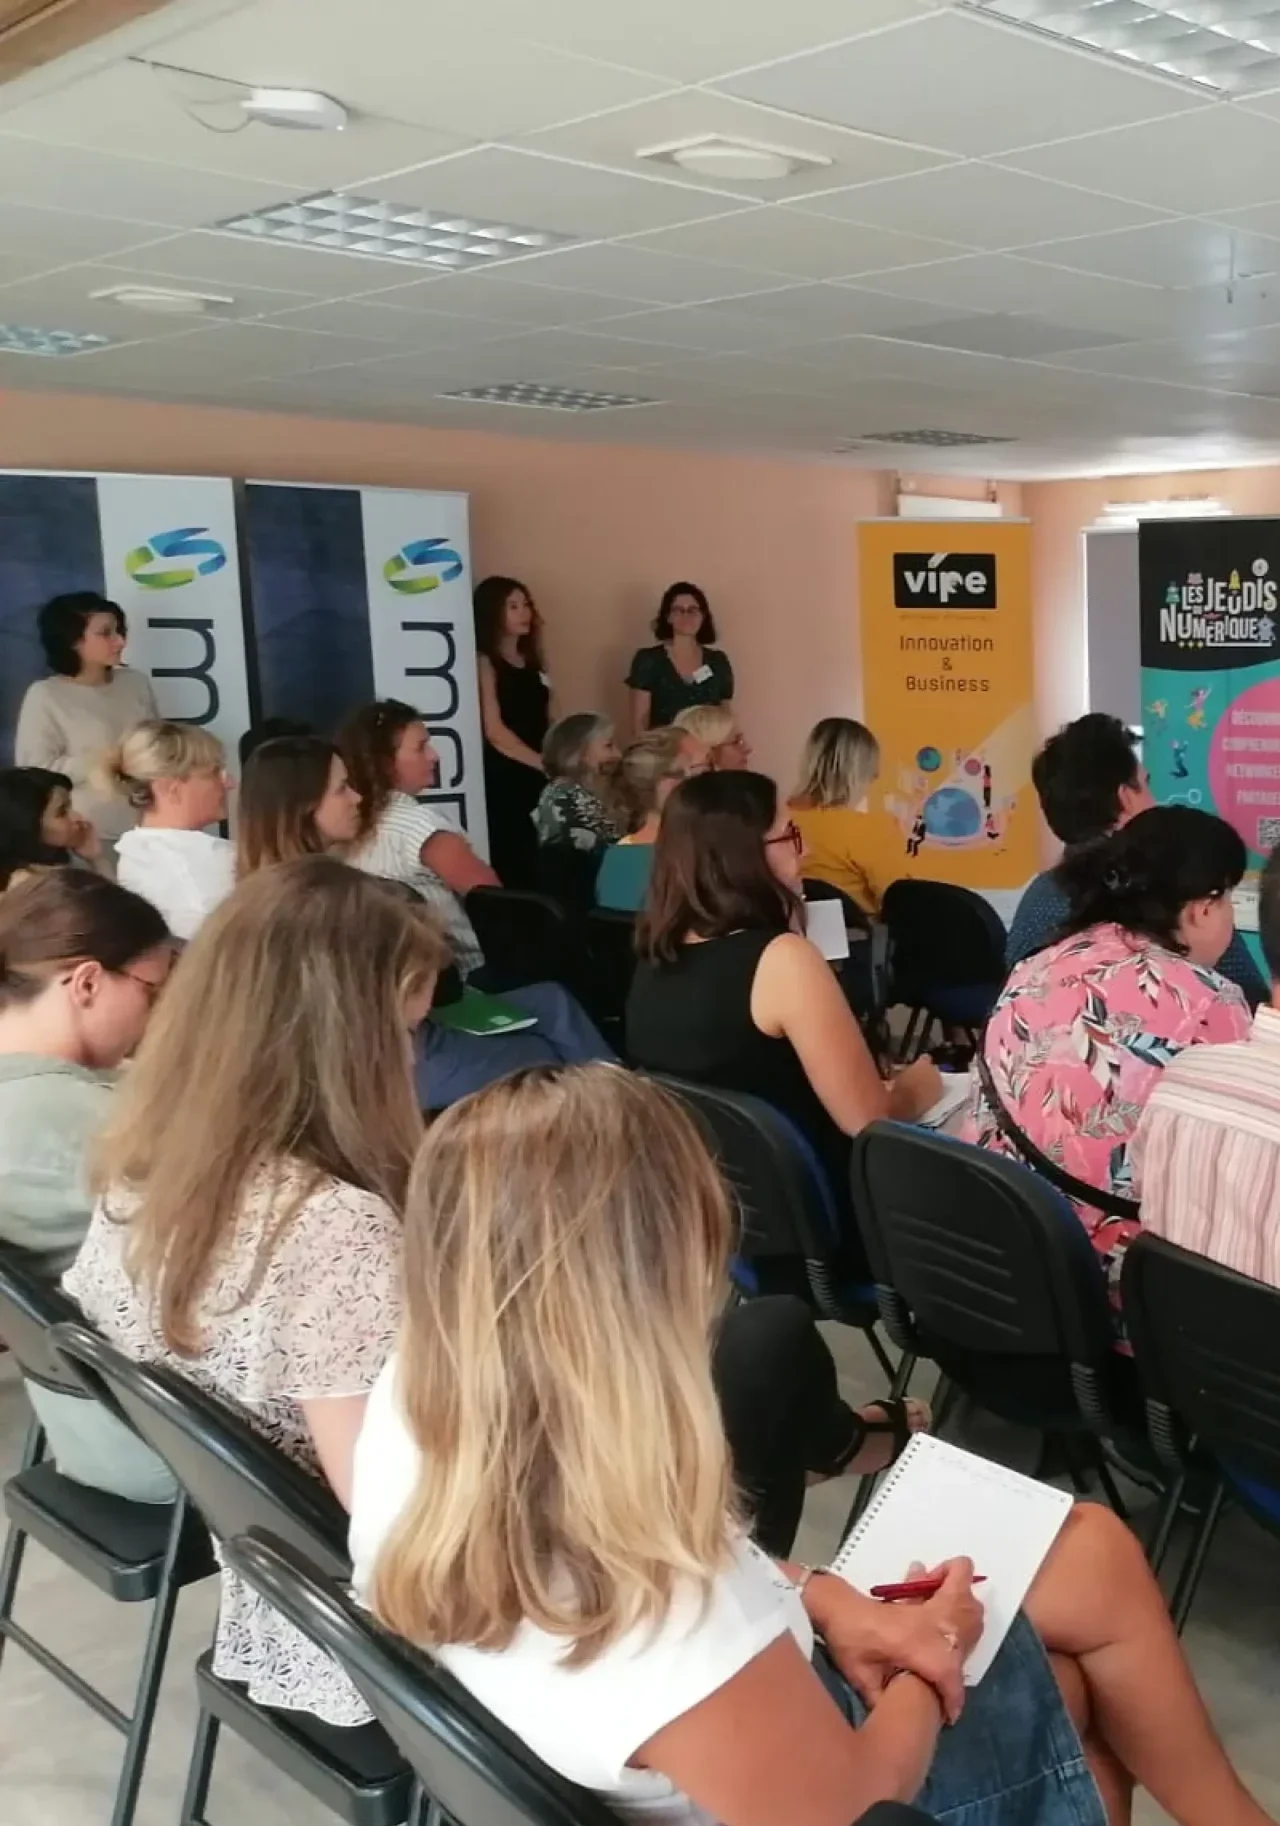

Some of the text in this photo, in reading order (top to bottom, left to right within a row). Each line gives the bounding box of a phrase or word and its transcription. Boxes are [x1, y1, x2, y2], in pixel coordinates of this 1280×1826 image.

[1181, 577, 1278, 614] LES JEUDIS
[900, 635, 994, 651] Innovation
[942, 656, 953, 671] &
[906, 675, 990, 692] Business
